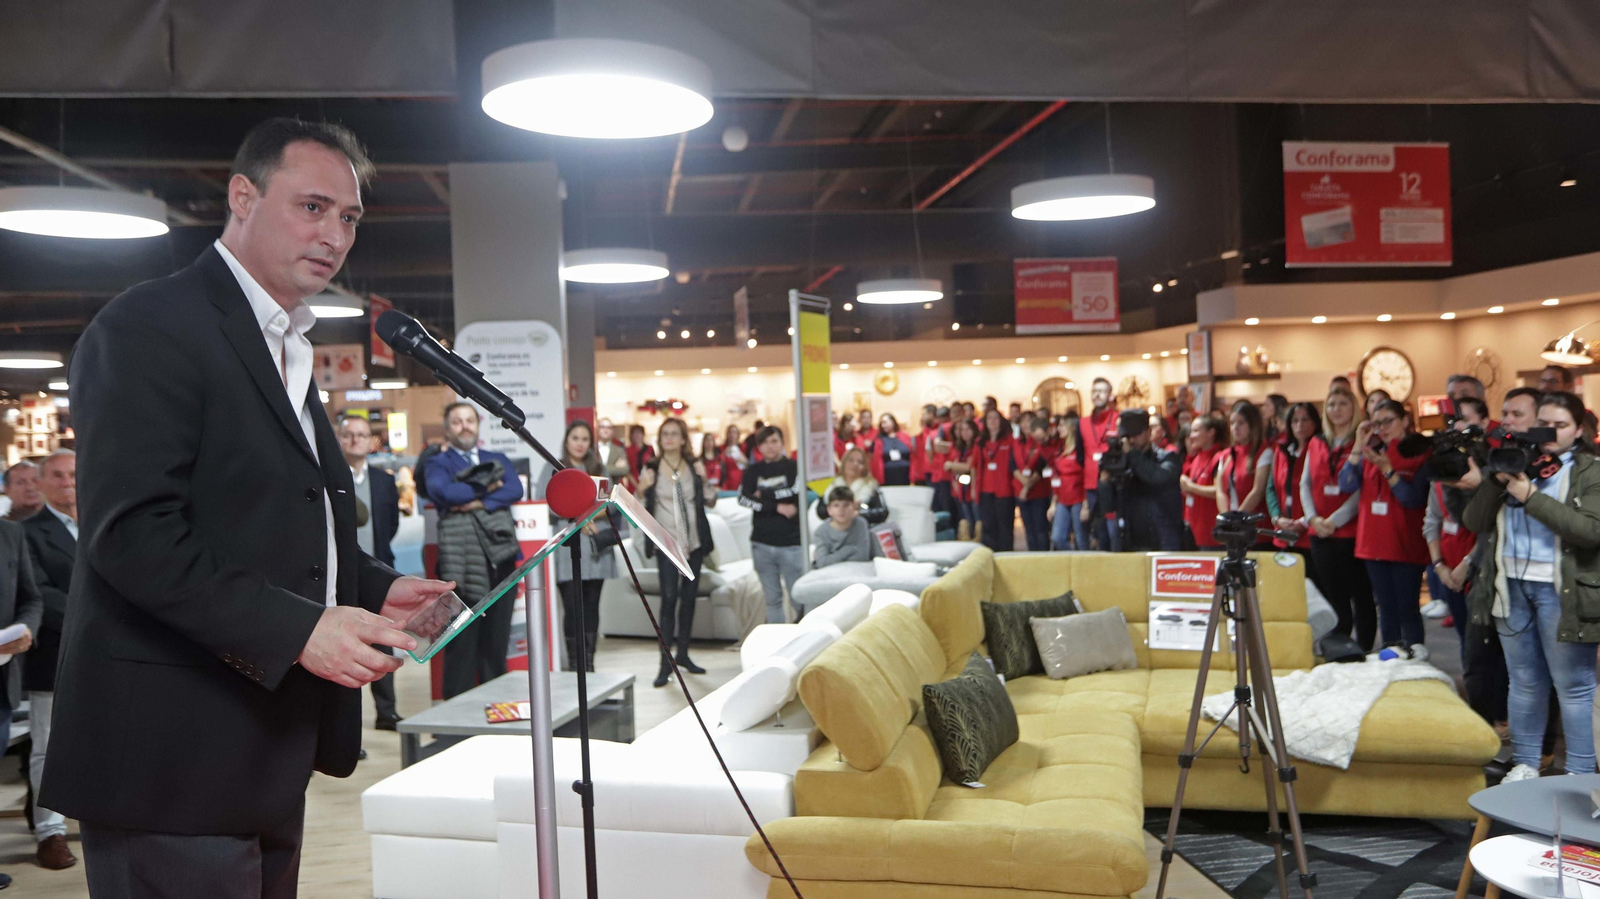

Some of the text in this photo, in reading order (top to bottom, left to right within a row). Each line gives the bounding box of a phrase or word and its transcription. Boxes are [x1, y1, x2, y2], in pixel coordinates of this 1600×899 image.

[1295, 149, 1391, 167] Conforama
[1399, 172, 1421, 194] 12
[1017, 279, 1068, 289] Conforama
[1157, 570, 1214, 582] Conforama
